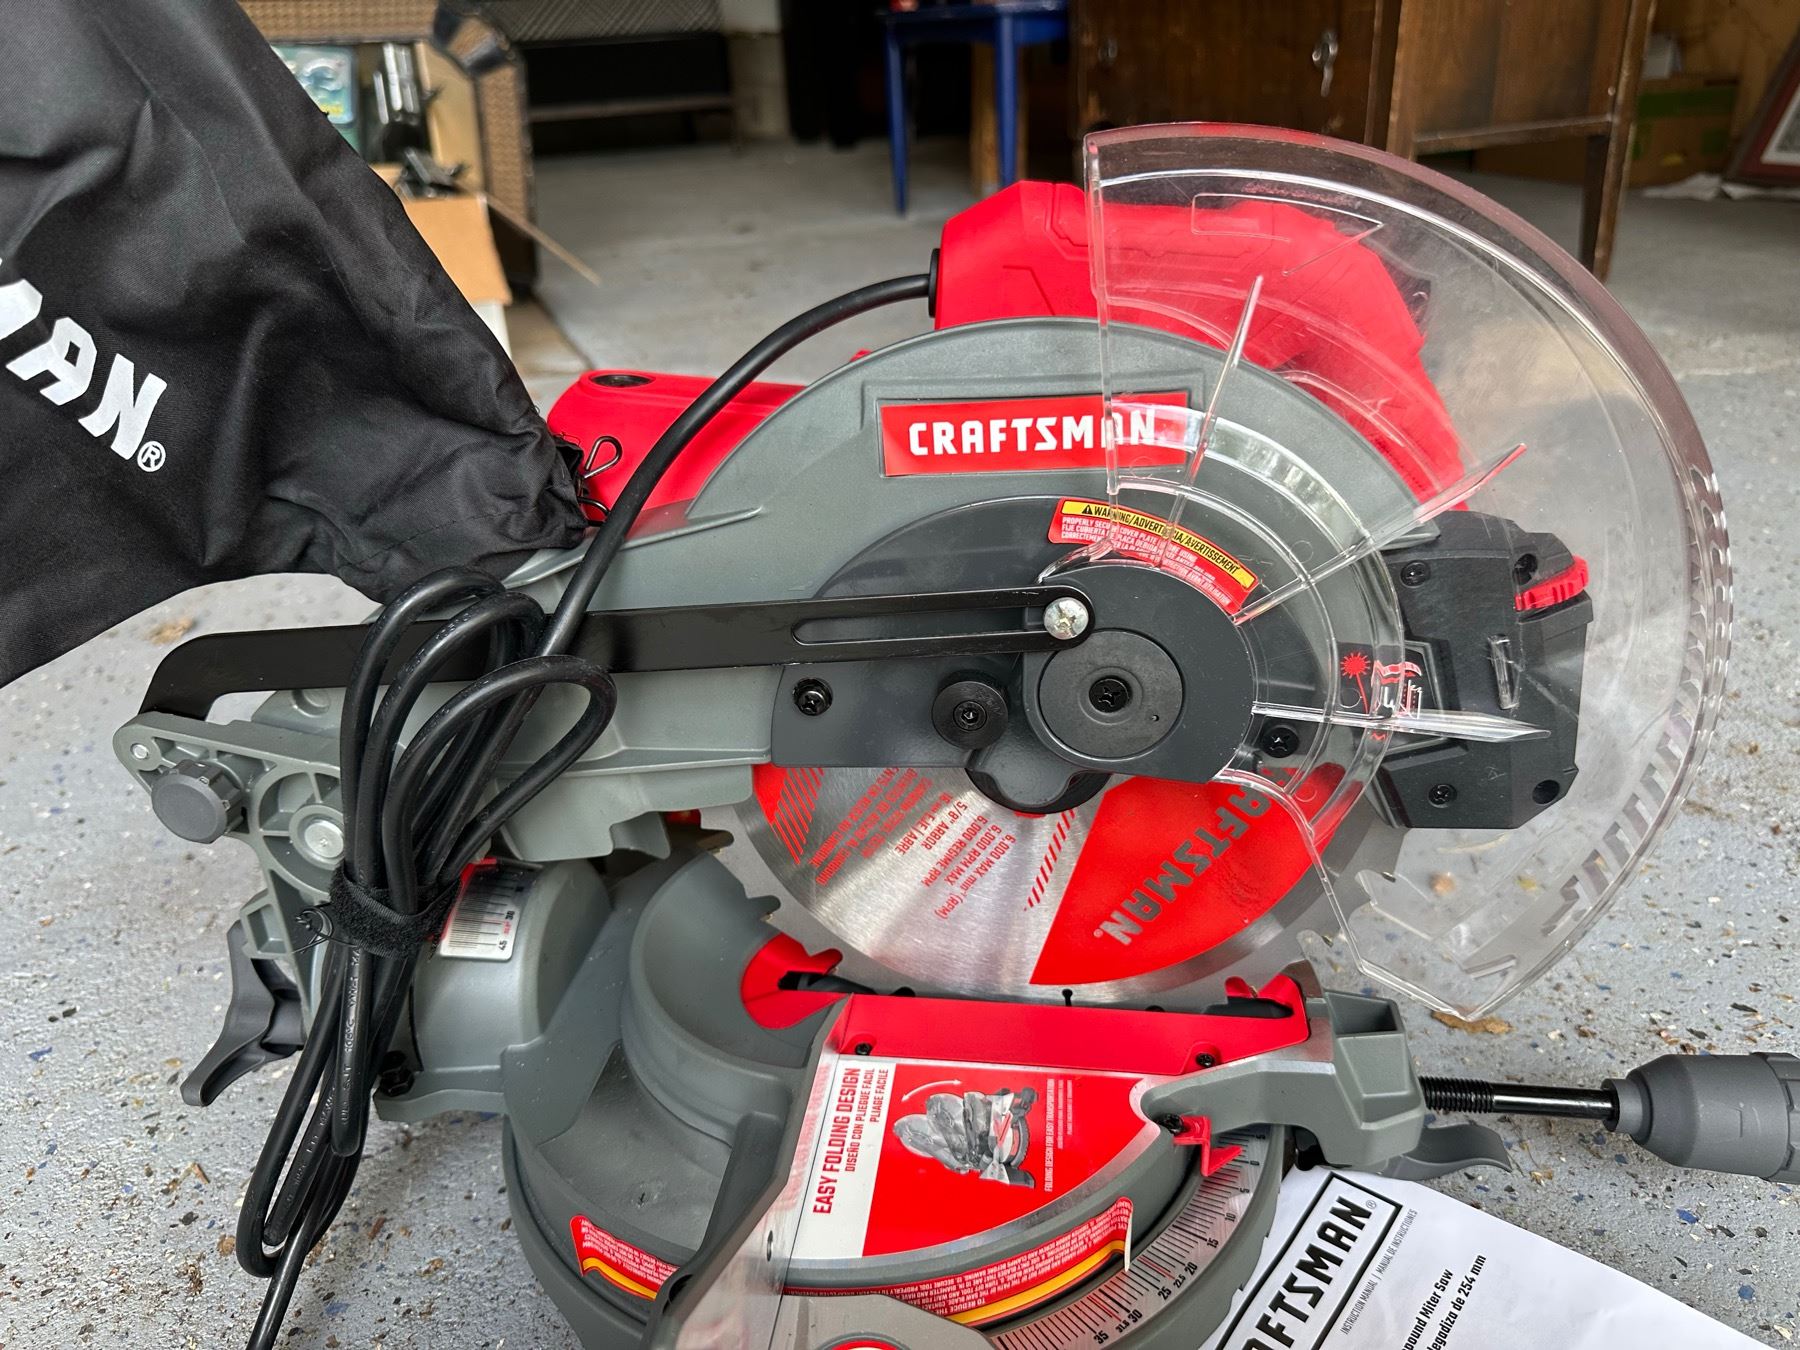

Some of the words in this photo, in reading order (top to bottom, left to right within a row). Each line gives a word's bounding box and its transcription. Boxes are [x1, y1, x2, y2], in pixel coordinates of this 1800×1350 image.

[908, 409, 1155, 455] CRAFTSMAN
[919, 813, 934, 830] EJE
[962, 815, 988, 841] 6,000
[895, 832, 918, 855] ABRE
[921, 821, 948, 850] ARBOR
[976, 825, 1002, 850] 6,000
[995, 834, 1016, 860] 6,000
[937, 840, 967, 870] REGIME
[960, 848, 977, 867] RPM
[921, 868, 942, 887] RPM
[944, 867, 961, 885] MAX
[977, 858, 995, 878] MAX
[836, 1068, 861, 1112] DESIGN
[876, 1069, 888, 1094] FACILE
[856, 1083, 870, 1121] PLIEGUE
[870, 1096, 884, 1122] PLIAGE
[852, 1124, 863, 1139] CON
[1045, 1136, 1053, 1146] FOR
[823, 1116, 850, 1172] FOLDING
[845, 1142, 860, 1172] DISEÑO
[813, 1176, 838, 1214] EASY
[1225, 1212, 1236, 1222] 10
[1207, 1237, 1219, 1248] 15
[1184, 1263, 1198, 1276] 20
[1340, 1298, 1366, 1335] INSTRUCTION
[1358, 1278, 1378, 1302] MANUAL
[1375, 1252, 1393, 1275] MANUAL
[1386, 1245, 1397, 1255] DE
[1392, 1208, 1418, 1248] INSTRUCTIONES
[1469, 1253, 1486, 1275] mm
[1173, 1274, 1186, 1289] 22.5
[1419, 1290, 1442, 1318] Miter
[1434, 1268, 1453, 1291] Saw
[1458, 1274, 1476, 1297] 254
[1158, 1287, 1172, 1301] 25
[1451, 1296, 1466, 1311] de
[1129, 1310, 1143, 1323] 30
[1093, 1331, 1109, 1344] 35
